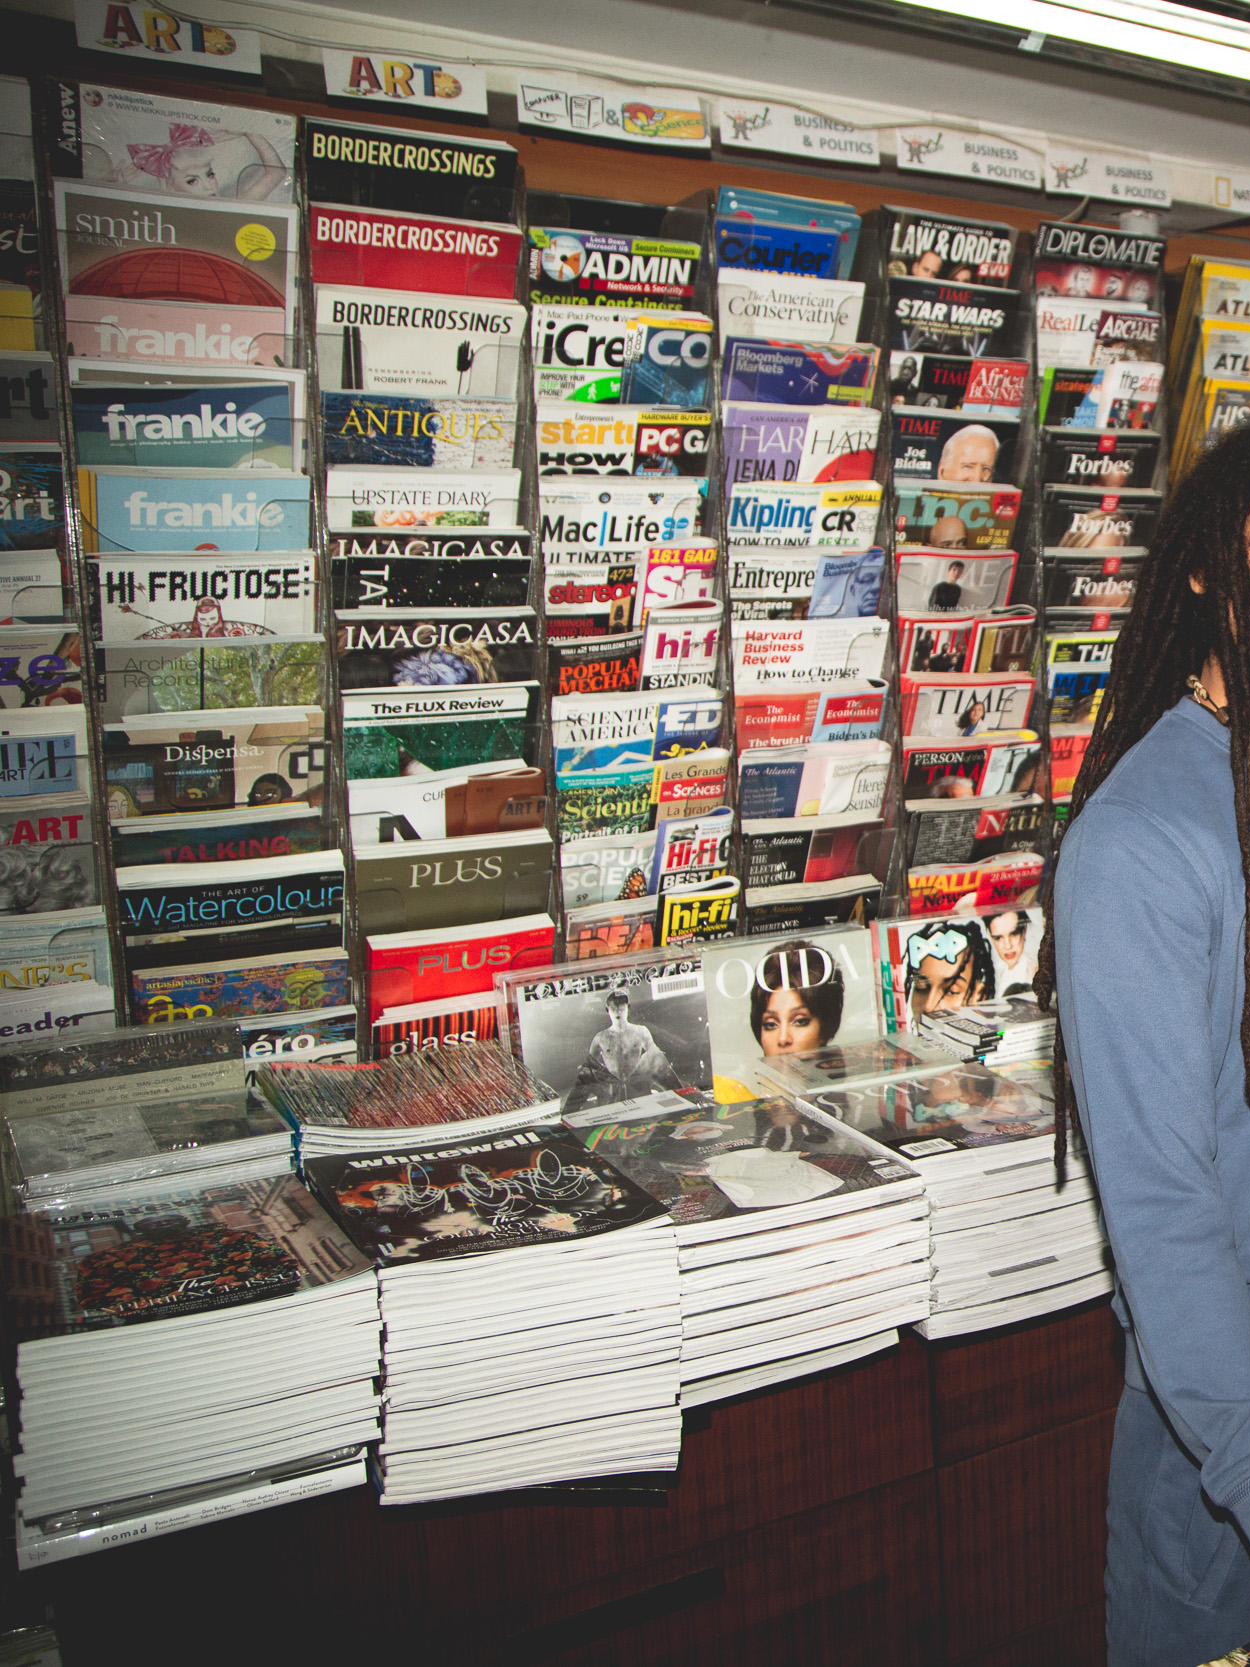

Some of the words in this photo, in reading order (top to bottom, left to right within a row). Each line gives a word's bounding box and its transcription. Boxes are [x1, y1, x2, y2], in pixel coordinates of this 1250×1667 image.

[350, 56, 442, 97] ART
[525, 92, 562, 109] COMPUTER
[605, 109, 620, 126] &
[794, 114, 855, 132] BUSINESS
[313, 132, 496, 178] BORDERCROSSINGS
[820, 137, 874, 154] POLITICS
[964, 141, 1018, 161] BUSINESS
[971, 161, 981, 173] &
[988, 163, 1036, 181] POLITICS
[1106, 165, 1153, 181] BUSINESS
[1111, 184, 1120, 195] &
[1125, 185, 1167, 200] POLITICS
[75, 210, 178, 245] smith
[317, 215, 500, 257] BORDERCROSSINGS
[635, 243, 658, 252] Secure
[659, 244, 695, 255] Containers
[719, 236, 830, 271] Courier
[890, 221, 936, 257] LAW
[950, 232, 1012, 267] ORDER
[1046, 227, 1165, 266] DIPLOMATIE
[581, 250, 692, 285] ADMIN
[977, 262, 1009, 277] SVU
[607, 281, 642, 292] Network
[652, 283, 683, 295] Security
[938, 286, 974, 303] TIME
[765, 288, 834, 308] American
[332, 300, 513, 334] BORDERCROSSINGS
[728, 295, 849, 325] Conservative
[895, 298, 947, 318] STAR
[950, 303, 1005, 329] WARS
[95, 315, 259, 361] frankie
[737, 348, 804, 367] Bloomberg
[736, 360, 784, 375] Markets
[374, 375, 413, 385] ROBERT
[416, 376, 448, 386] FRANK
[102, 402, 266, 441] frankie
[339, 405, 504, 445] ANTIQUES
[641, 413, 679, 421] HARDWARE
[899, 416, 943, 437] TIME
[639, 427, 681, 454] PC
[539, 452, 627, 466] HOW
[904, 446, 926, 460] Joe
[894, 457, 932, 471] Biden
[1068, 453, 1134, 476] Forbes
[352, 489, 431, 506] UPSTATE
[437, 490, 492, 506] DIARY
[124, 491, 285, 527] frankie
[821, 510, 857, 532] CR
[1070, 512, 1134, 537] Forbes
[337, 538, 524, 558] IMAGICASA
[650, 549, 680, 563] 161
[609, 568, 634, 580] 472
[106, 571, 136, 604] HI
[1072, 576, 1136, 598] Forbes
[345, 621, 534, 650] IMAGICASA
[745, 630, 803, 642] Harvard
[744, 640, 805, 654] Business
[742, 654, 792, 665] Review
[124, 672, 200, 689] Record
[756, 668, 789, 680] How
[791, 667, 806, 677] to
[808, 666, 860, 680] Change
[371, 702, 402, 715] The
[405, 700, 446, 714] FLUX
[448, 696, 504, 712] Review
[767, 705, 784, 715] The
[846, 699, 863, 708] The
[933, 686, 1017, 715] TIME
[745, 712, 801, 725] Economist
[826, 708, 879, 719] Economist
[749, 738, 769, 748] The
[770, 735, 804, 747] brutal
[164, 743, 264, 765] Dispensa
[914, 752, 964, 767] PERSON
[665, 769, 683, 780] Les
[687, 764, 727, 779] Grands
[763, 766, 797, 776] Atlantic
[505, 800, 533, 816] ART
[667, 805, 680, 816] La
[158, 835, 292, 864] TALKING
[771, 835, 804, 847] Atlantic
[750, 861, 788, 875] ELECTION
[751, 854, 768, 864] THE
[410, 854, 502, 889] PLUS
[748, 874, 769, 885] THAT
[125, 884, 344, 927] Watercolour
[671, 899, 732, 929] hi-fi
[416, 944, 512, 976] PLUS
[348, 1132, 543, 1169] whitewall
[102, 1524, 148, 1545] nomad
